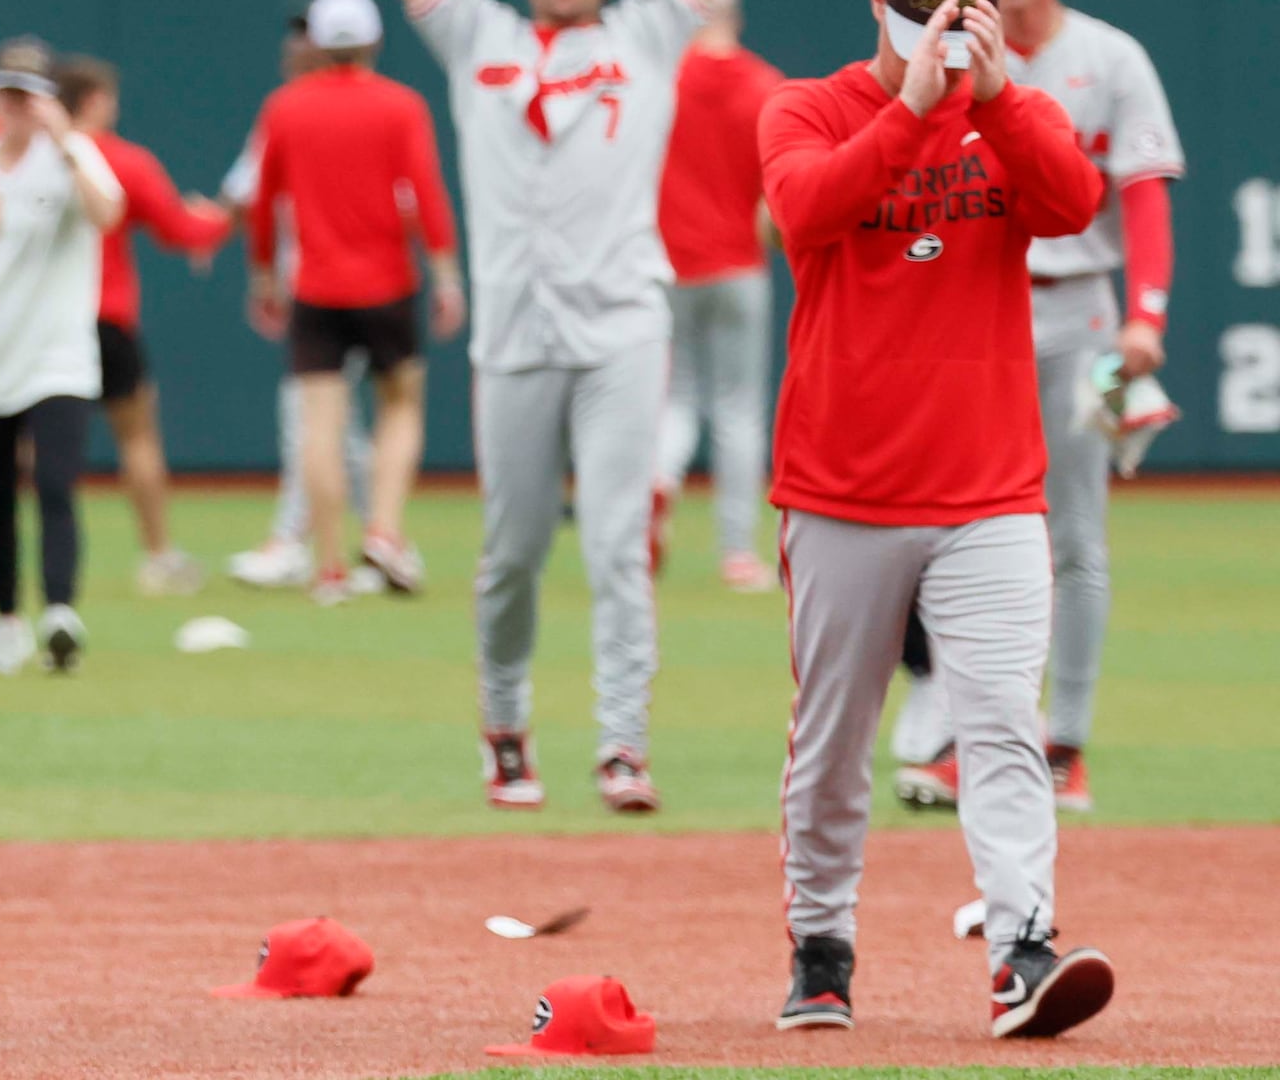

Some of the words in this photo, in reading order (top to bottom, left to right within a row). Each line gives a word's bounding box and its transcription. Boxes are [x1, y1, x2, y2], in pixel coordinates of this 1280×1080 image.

[597, 93, 620, 140] 7
[859, 187, 1007, 233] ULLDOGS
[1234, 178, 1280, 287] 1
